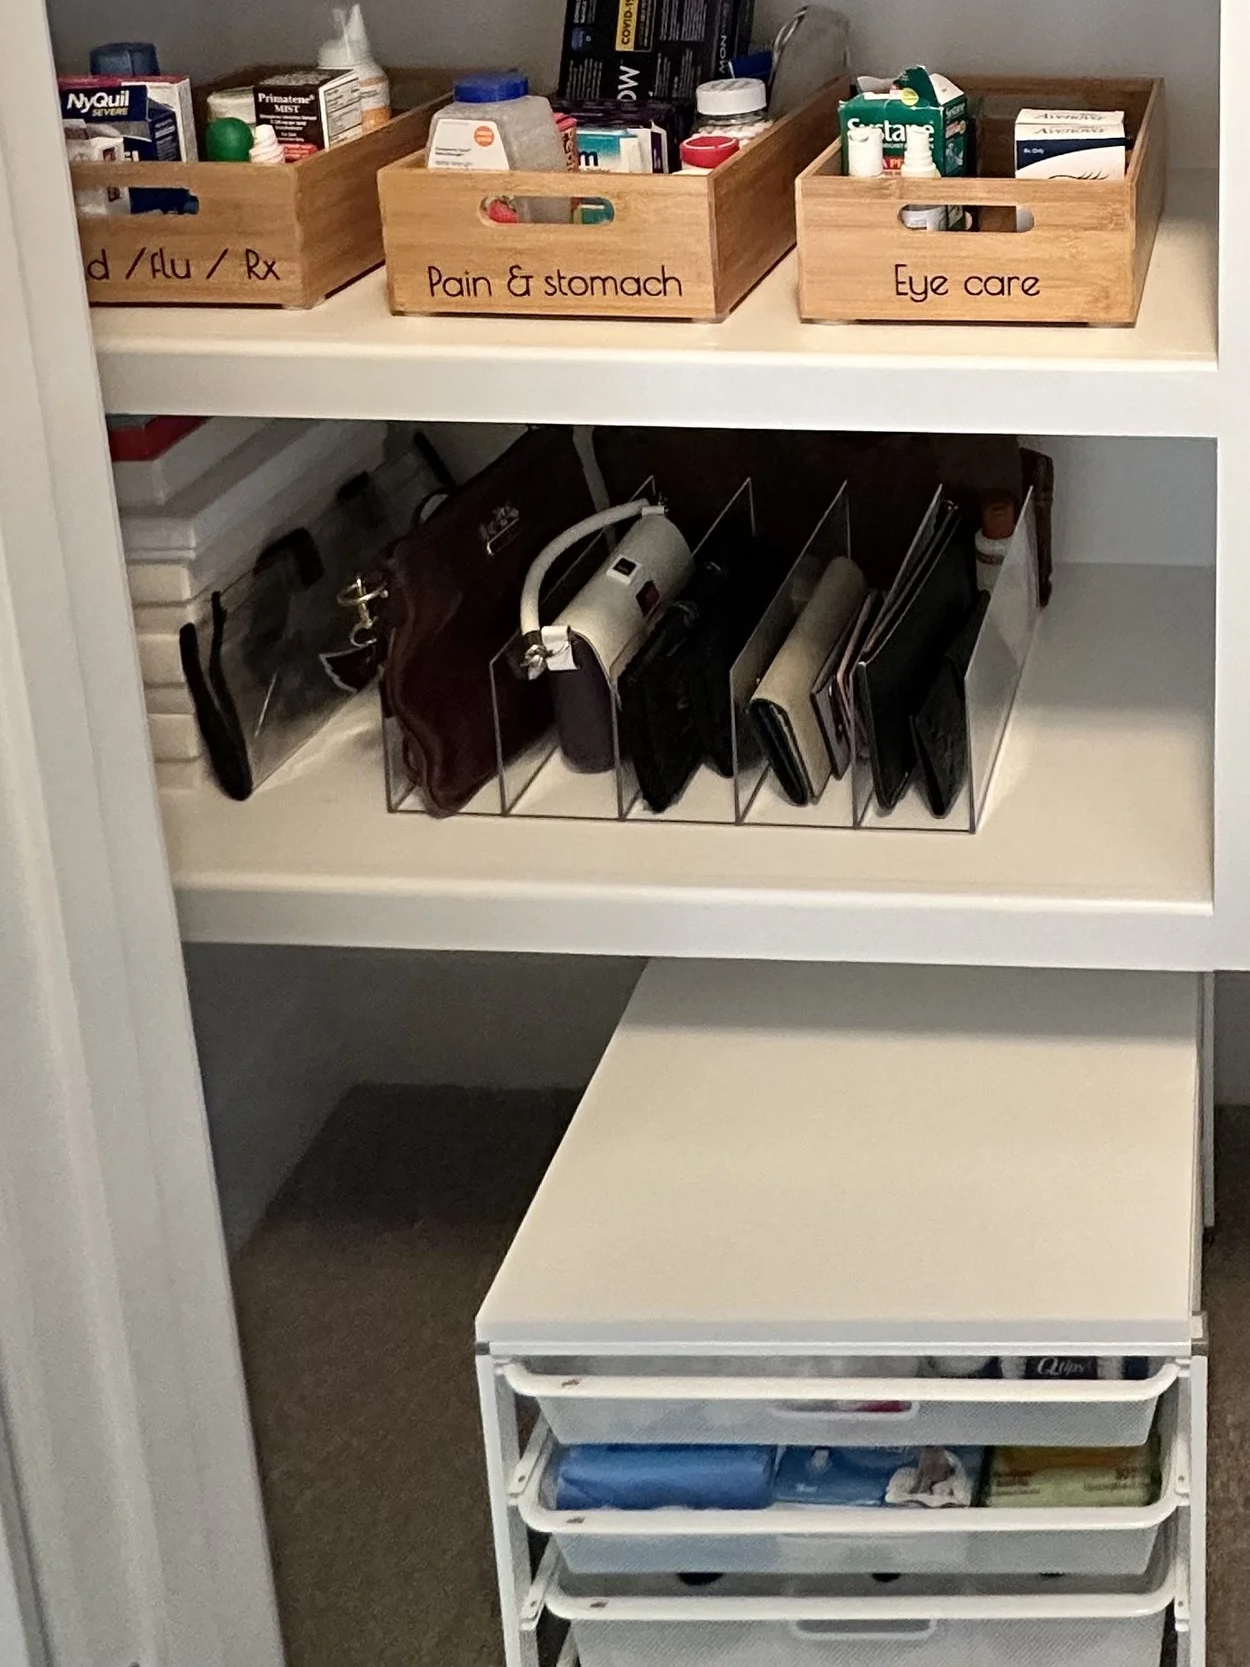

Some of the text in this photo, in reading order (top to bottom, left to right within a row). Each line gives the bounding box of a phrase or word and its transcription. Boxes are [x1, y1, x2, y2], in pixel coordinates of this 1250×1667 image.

[67, 90, 130, 113] NyQuil
[92, 108, 129, 117] SEVERE
[274, 104, 301, 114] MIST
[245, 251, 280, 280] Rx
[427, 264, 682, 298] Pain & stomach
[894, 263, 1041, 302] Eye care
